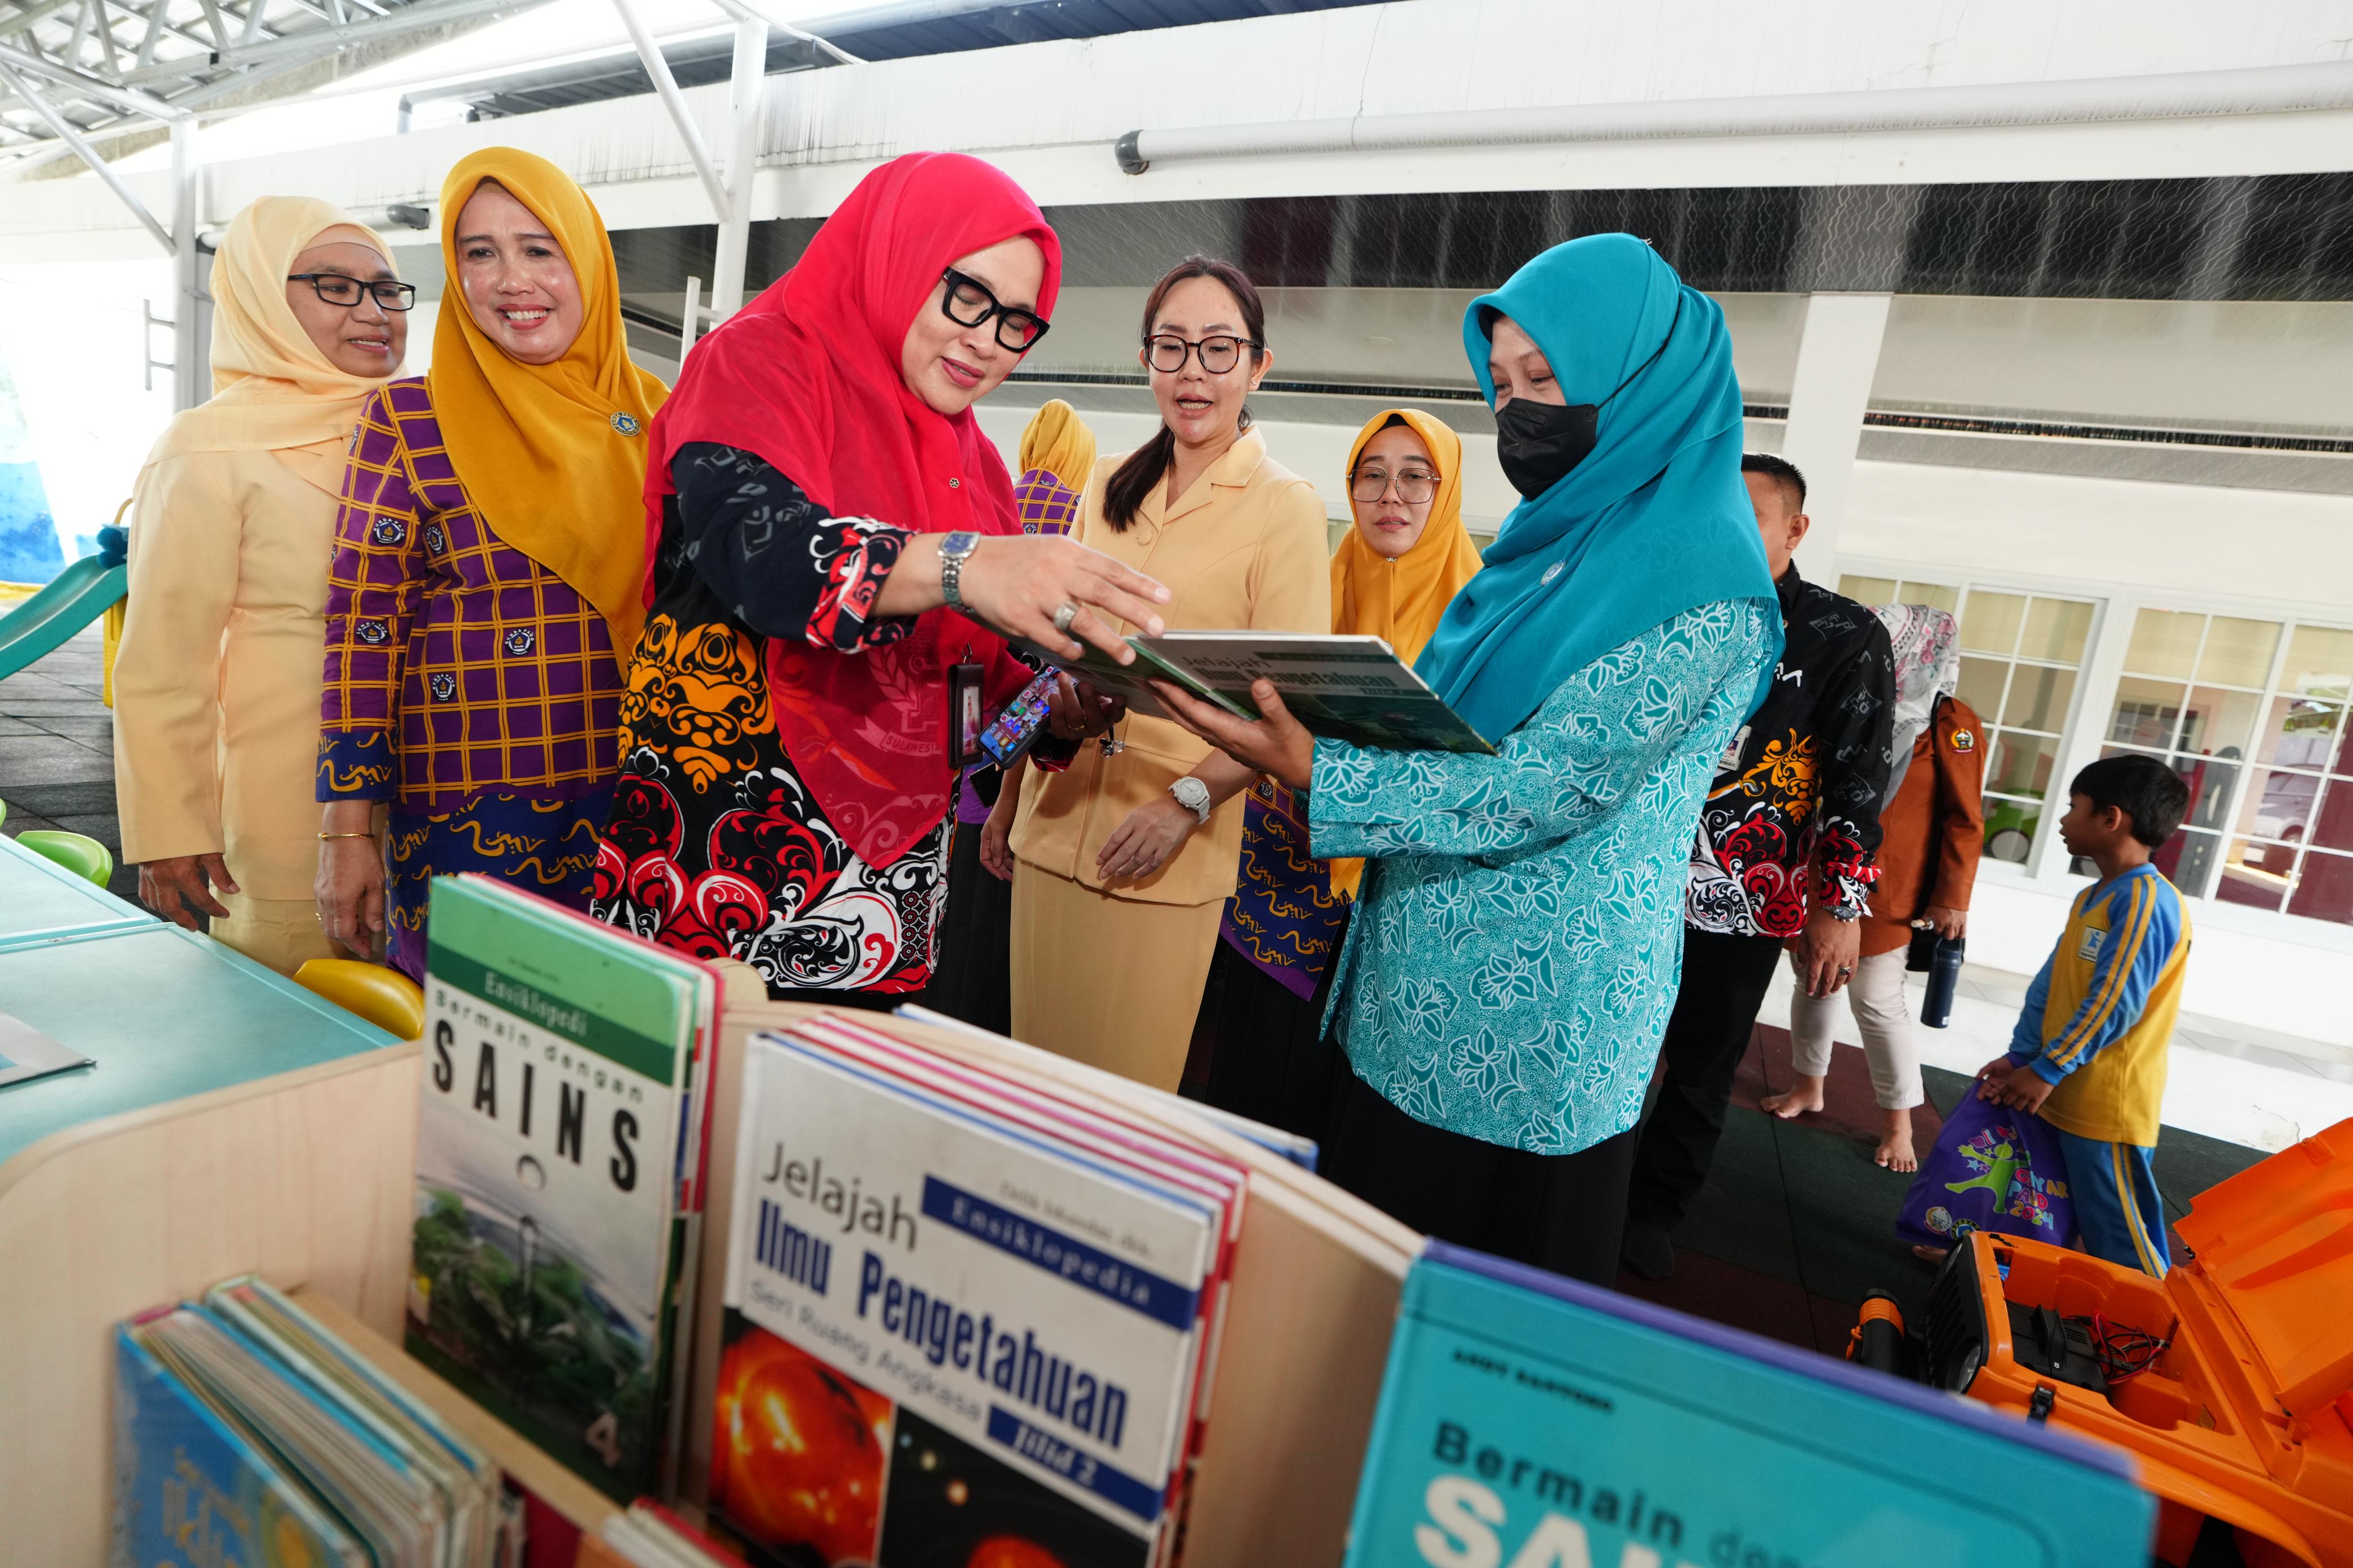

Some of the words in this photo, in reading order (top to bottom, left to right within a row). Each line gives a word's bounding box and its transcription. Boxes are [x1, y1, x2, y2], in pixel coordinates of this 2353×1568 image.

[373, 518, 392, 532] BUNDA
[505, 629, 522, 645] BUNDA
[523, 629, 535, 641] PAUD
[1182, 656, 1272, 669] Jelajah
[432, 673, 444, 690] BUNDA
[1193, 667, 1251, 682] Ilmu
[1246, 669, 1398, 688] Pengetahuan
[485, 971, 588, 1036] Ensiklopedi
[435, 989, 532, 1049] Bermain
[544, 1043, 644, 1104] dengan
[432, 1019, 641, 1192] SAINS
[762, 1141, 918, 1251] Jelajah
[2007, 1180, 2049, 1210] PAUD
[2009, 1200, 2054, 1231] 2024
[951, 1195, 1152, 1306] Ensiklopedia
[751, 1278, 793, 1318] Seri
[798, 1303, 870, 1367] Ruang
[876, 1349, 982, 1423] Angkasa
[756, 1197, 832, 1298] Ilmu
[856, 1248, 1128, 1450] Pengetahuan
[585, 1411, 620, 1469] 4
[1014, 1423, 1075, 1476] Jilid
[1076, 1455, 1098, 1488] 2
[1432, 1418, 1685, 1549] Bermain
